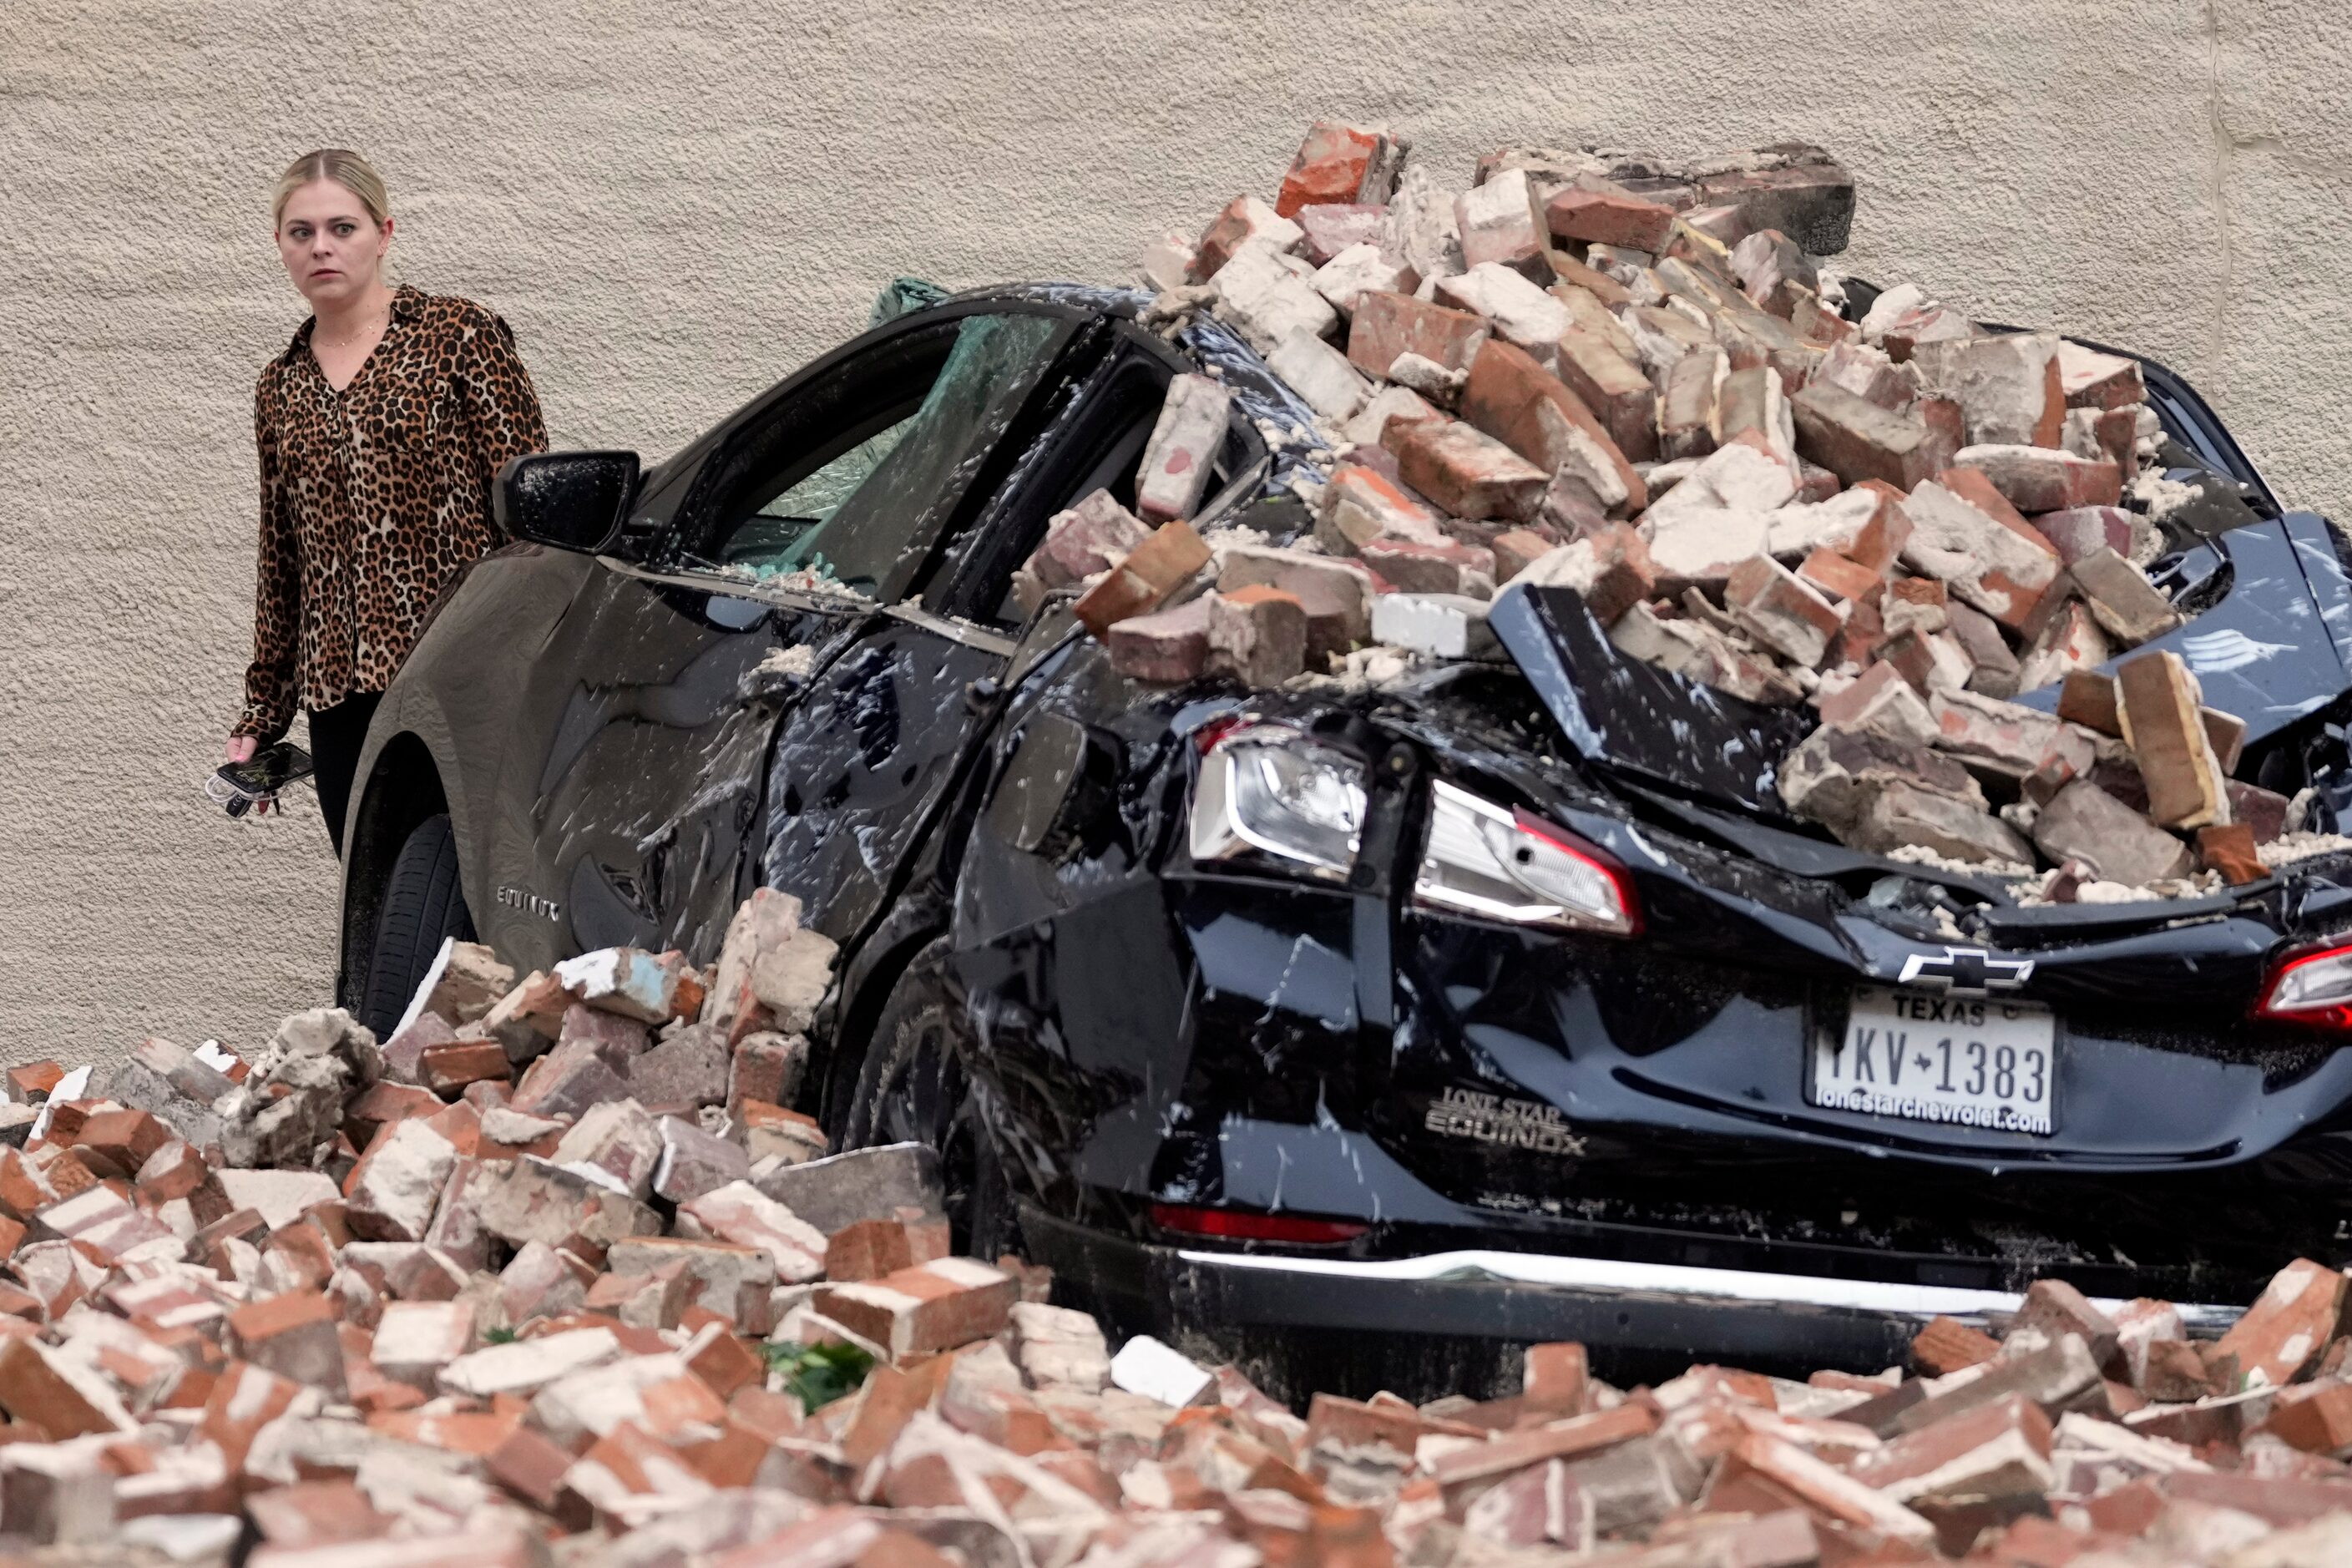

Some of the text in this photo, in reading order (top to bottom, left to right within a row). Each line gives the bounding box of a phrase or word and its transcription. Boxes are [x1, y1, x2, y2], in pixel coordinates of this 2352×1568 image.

[497, 886, 559, 922] EQUINOX
[1893, 994, 1985, 1027] TEXAS
[1443, 1086, 1561, 1124] LONE STAR
[1815, 1088, 2051, 1135] lonestarchevrolet.com
[1424, 1109, 1588, 1157] EQUINOX
